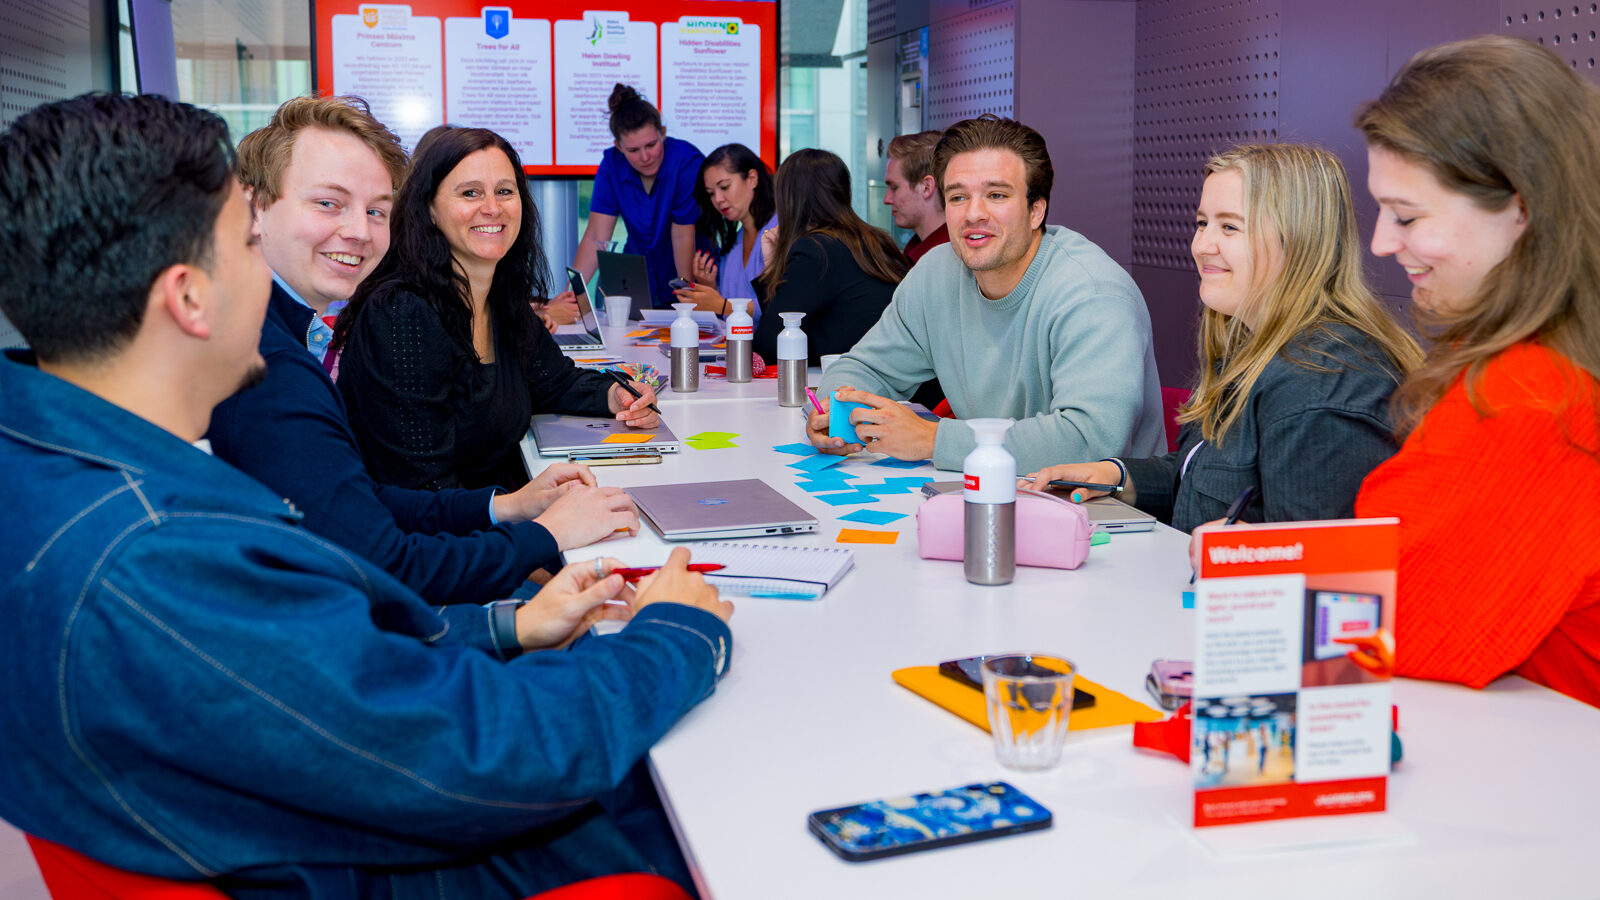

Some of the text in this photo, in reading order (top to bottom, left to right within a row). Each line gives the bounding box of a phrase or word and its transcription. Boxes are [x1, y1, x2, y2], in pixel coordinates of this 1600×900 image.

[357, 32, 385, 40] Prinses
[603, 53, 631, 61] Dowling
[1208, 542, 1304, 564] Welcome!
